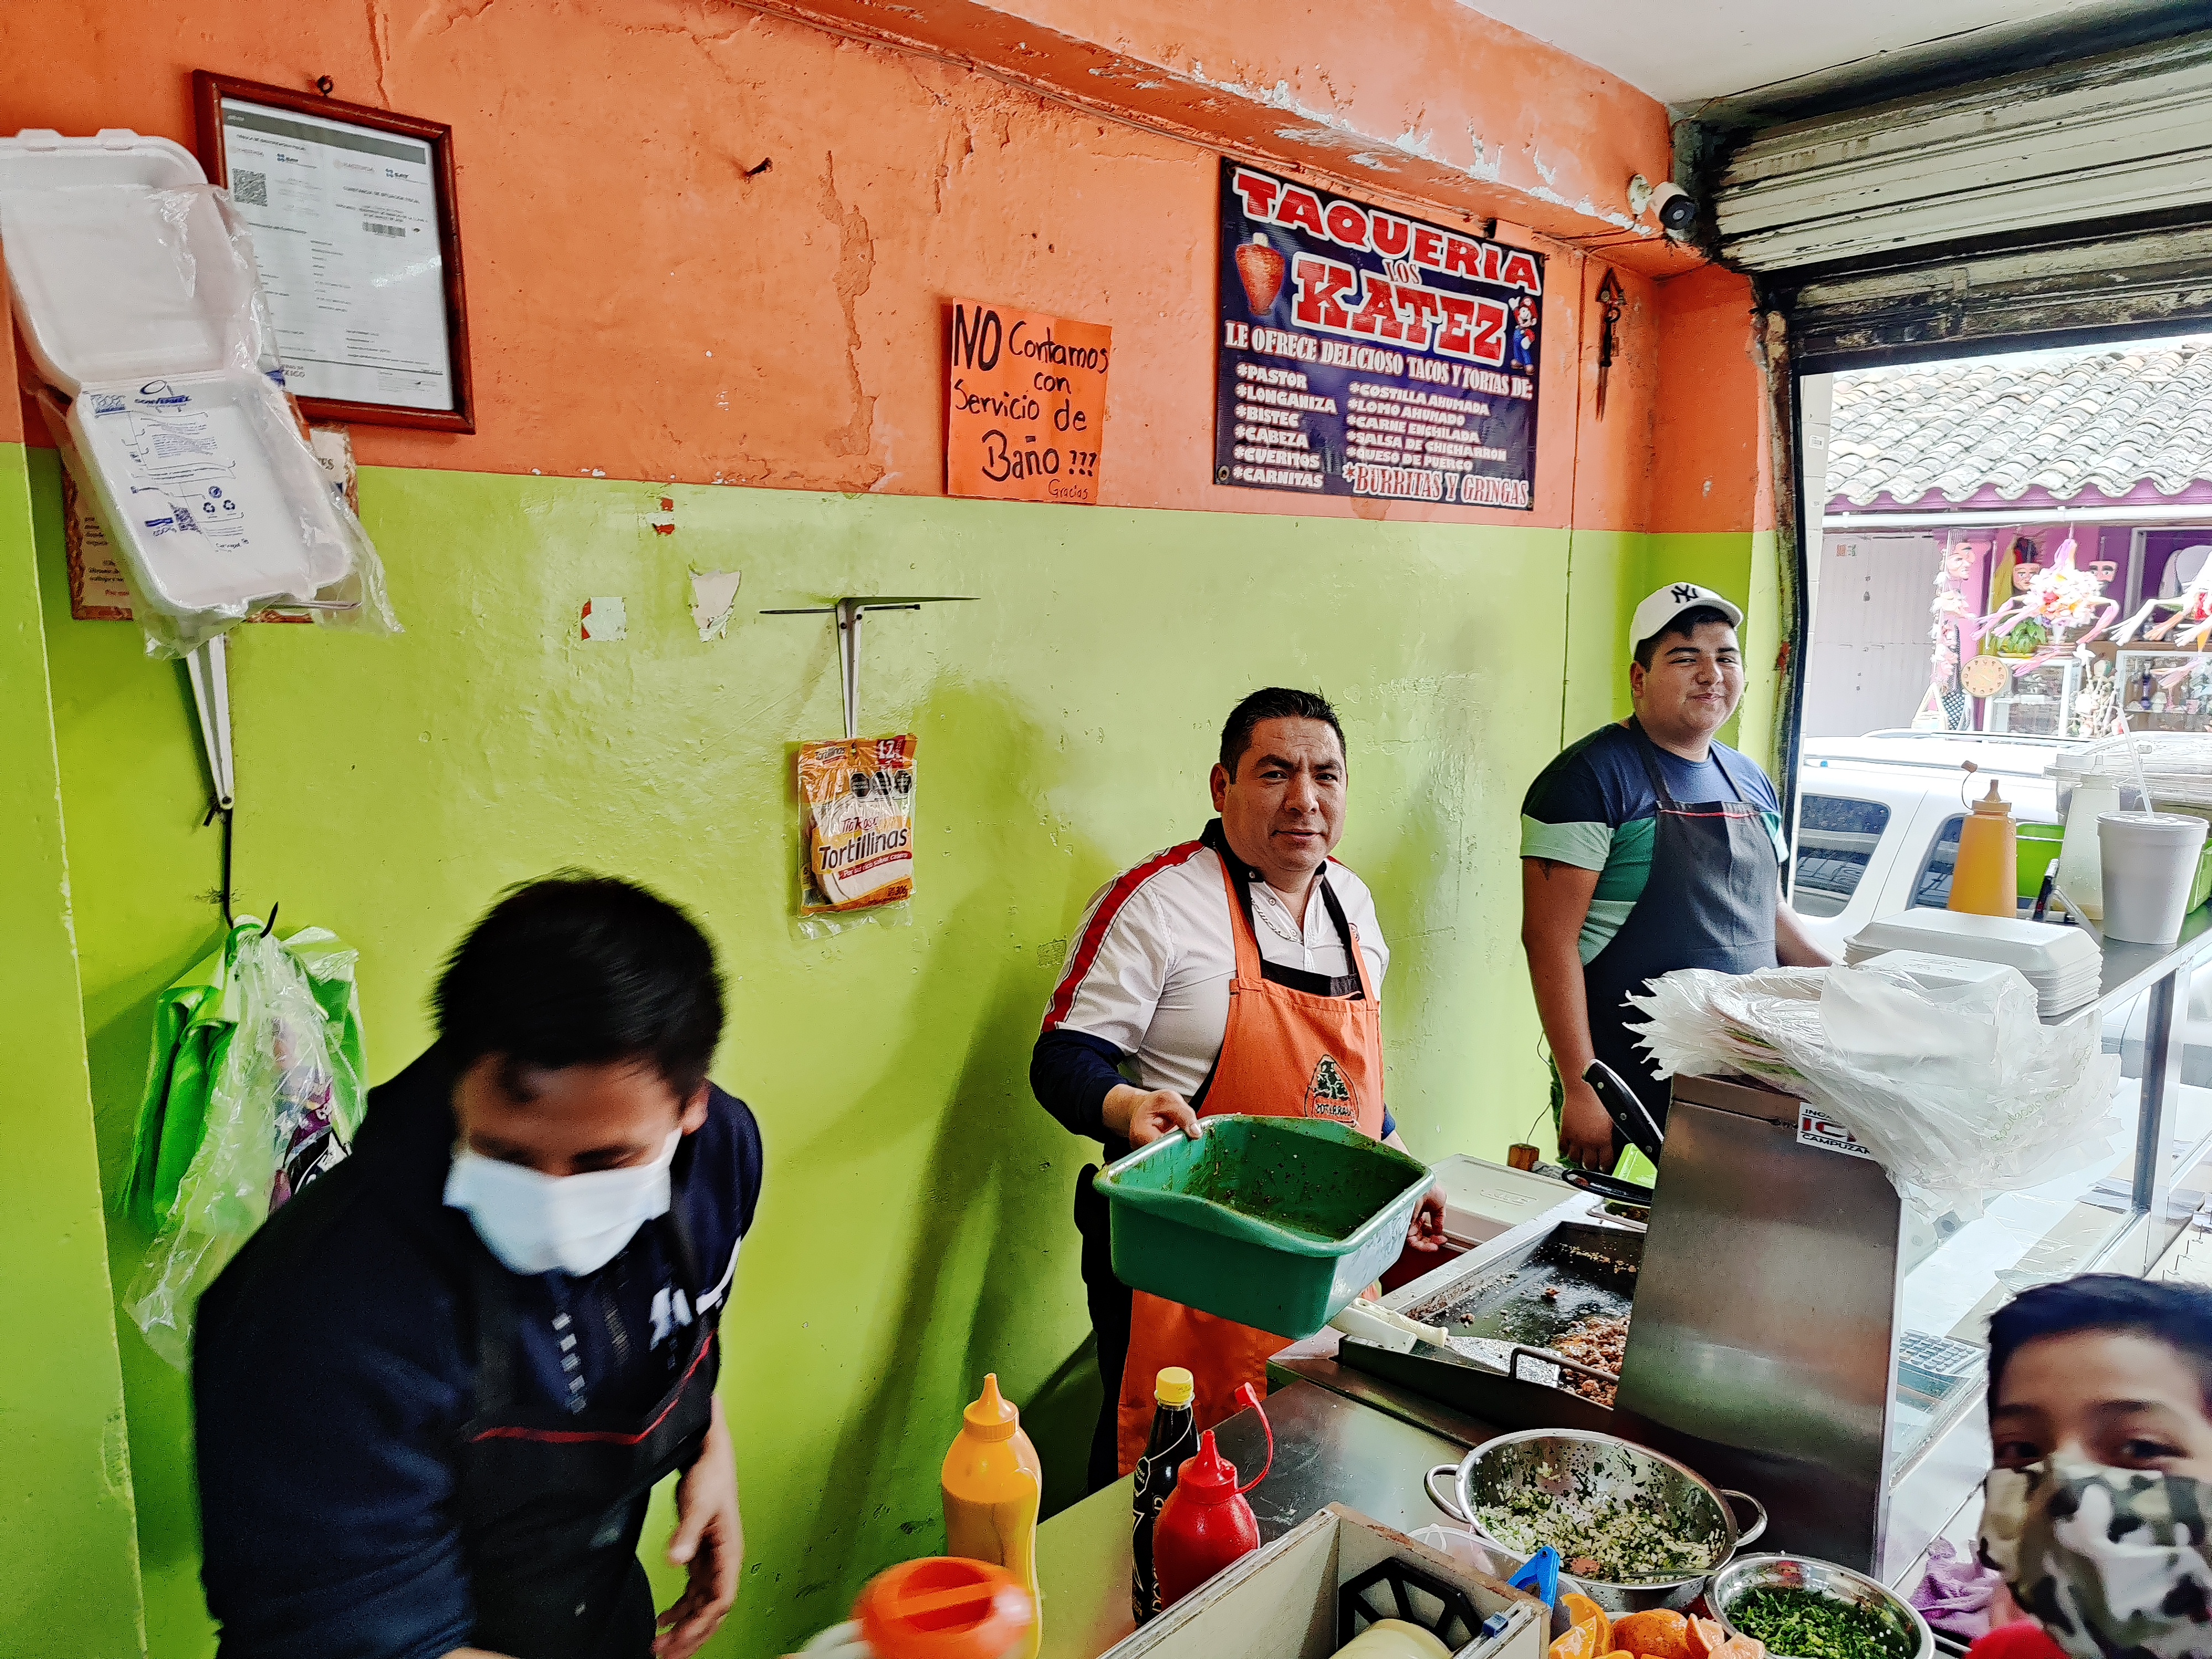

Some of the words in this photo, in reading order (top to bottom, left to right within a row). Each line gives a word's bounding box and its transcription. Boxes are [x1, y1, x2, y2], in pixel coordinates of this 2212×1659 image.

[1233, 167, 1542, 295] TAQUERIA
[1384, 259, 1421, 285] LOS
[1291, 251, 1509, 367] KATEZ
[954, 304, 1002, 371] NO
[1008, 320, 1109, 374] Contamos
[1225, 321, 1249, 349] LE
[1251, 326, 1318, 362] OFRECE
[1320, 339, 1404, 375] DELICIOSO
[1406, 354, 1449, 385] TACOS
[1452, 364, 1463, 387] Y
[1462, 367, 1509, 396] TORTAS
[1034, 372, 1072, 395] con
[953, 378, 1040, 420] Servicio
[1053, 398, 1087, 431] de
[1401, 406, 1465, 426] AHUMADO
[1428, 394, 1490, 416] AHUMADA
[1407, 421, 1481, 444] ENCHILADA
[1402, 452, 1422, 467] DE
[1423, 455, 1473, 472] PUERCO
[1404, 437, 1423, 451] DE
[1424, 439, 1507, 462] CHICHARRON
[1048, 478, 1088, 500] Gracias
[1445, 473, 1459, 501] Y
[1461, 474, 1528, 507] GRINGAS
[877, 740, 895, 759] 12
[819, 828, 908, 870] Tortillinas
